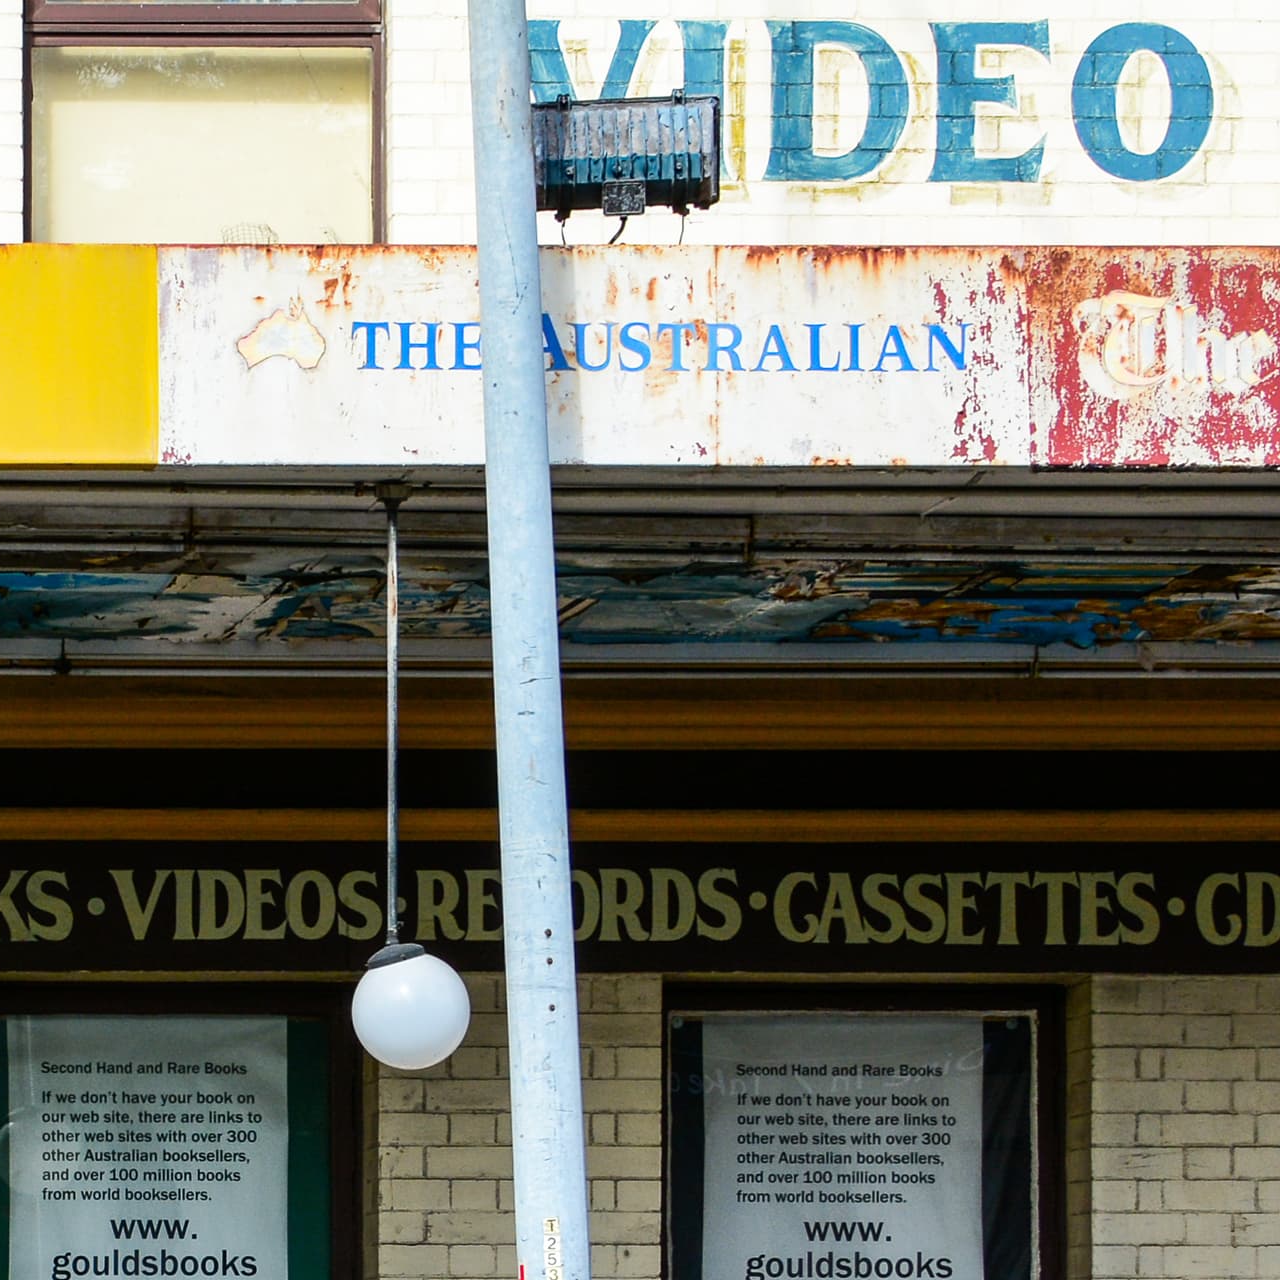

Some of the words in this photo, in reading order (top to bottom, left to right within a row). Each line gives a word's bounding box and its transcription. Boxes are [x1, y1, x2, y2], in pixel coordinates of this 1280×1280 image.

[351, 321, 482, 371] THE
[540, 312, 974, 372] AUSTRALIAN
[109, 868, 383, 942] VIDEOS
[415, 868, 741, 942] REORDS
[773, 870, 1162, 946] CASSETTES
[40, 1060, 93, 1075] Second
[95, 1060, 134, 1075] Hand
[136, 1062, 163, 1075] and
[167, 1061, 201, 1075] Rare
[203, 1061, 249, 1076] Books
[735, 1063, 788, 1078] Second
[790, 1063, 828, 1078] Hand
[830, 1063, 859, 1077] and
[861, 1063, 896, 1078] Rare
[898, 1063, 944, 1078] Books
[41, 1091, 52, 1105] If
[54, 1092, 77, 1105] we
[79, 1090, 118, 1105] don't
[121, 1090, 157, 1105] have
[159, 1093, 194, 1108] your
[195, 1090, 234, 1105] book
[236, 1094, 256, 1105] on
[736, 1092, 749, 1107] If
[749, 1095, 772, 1107] we
[774, 1092, 813, 1107] don't
[815, 1092, 852, 1107] have
[854, 1095, 888, 1110] your
[890, 1092, 929, 1108] book
[930, 1096, 950, 1108] on
[41, 1112, 66, 1124] our
[70, 1110, 99, 1124] web
[102, 1110, 134, 1126] site,
[137, 1110, 177, 1124] there
[179, 1112, 205, 1124] are
[208, 1110, 243, 1125] links
[247, 1111, 263, 1125] to
[736, 1114, 762, 1126] our
[764, 1112, 795, 1127] web
[797, 1112, 829, 1129] site,
[831, 1112, 872, 1127] there
[874, 1115, 901, 1127] are
[903, 1112, 939, 1127] links
[941, 1113, 957, 1127] to
[41, 1129, 81, 1143] other
[83, 1128, 115, 1144] web
[116, 1128, 153, 1143] sites
[155, 1129, 188, 1144] with
[190, 1129, 224, 1144] over
[226, 1130, 258, 1144] 300
[736, 1131, 776, 1145] other
[777, 1131, 809, 1146] web
[811, 1131, 847, 1146] sites
[849, 1131, 882, 1146] with
[885, 1134, 919, 1146] over
[920, 1131, 952, 1146] 300
[41, 1148, 81, 1162] other
[83, 1149, 158, 1163] Australian
[162, 1149, 251, 1165] booksellers,
[736, 1150, 776, 1165] other
[777, 1150, 853, 1165] Australian
[856, 1151, 945, 1167] booksellers,
[41, 1167, 70, 1182] and
[73, 1170, 106, 1182] over
[109, 1168, 139, 1183] 100
[142, 1168, 192, 1183] million
[194, 1167, 242, 1182] books
[736, 1170, 764, 1184] and
[767, 1171, 799, 1184] over
[802, 1170, 833, 1184] 100
[836, 1170, 887, 1185] million
[891, 1170, 936, 1185] books
[41, 1186, 77, 1201] from
[80, 1187, 121, 1201] world
[124, 1186, 213, 1202] booksellers.
[735, 1189, 771, 1203] from
[773, 1189, 815, 1204] world
[818, 1189, 908, 1204] booksellers.
[109, 1218, 198, 1240] www.
[802, 1221, 892, 1243] www.
